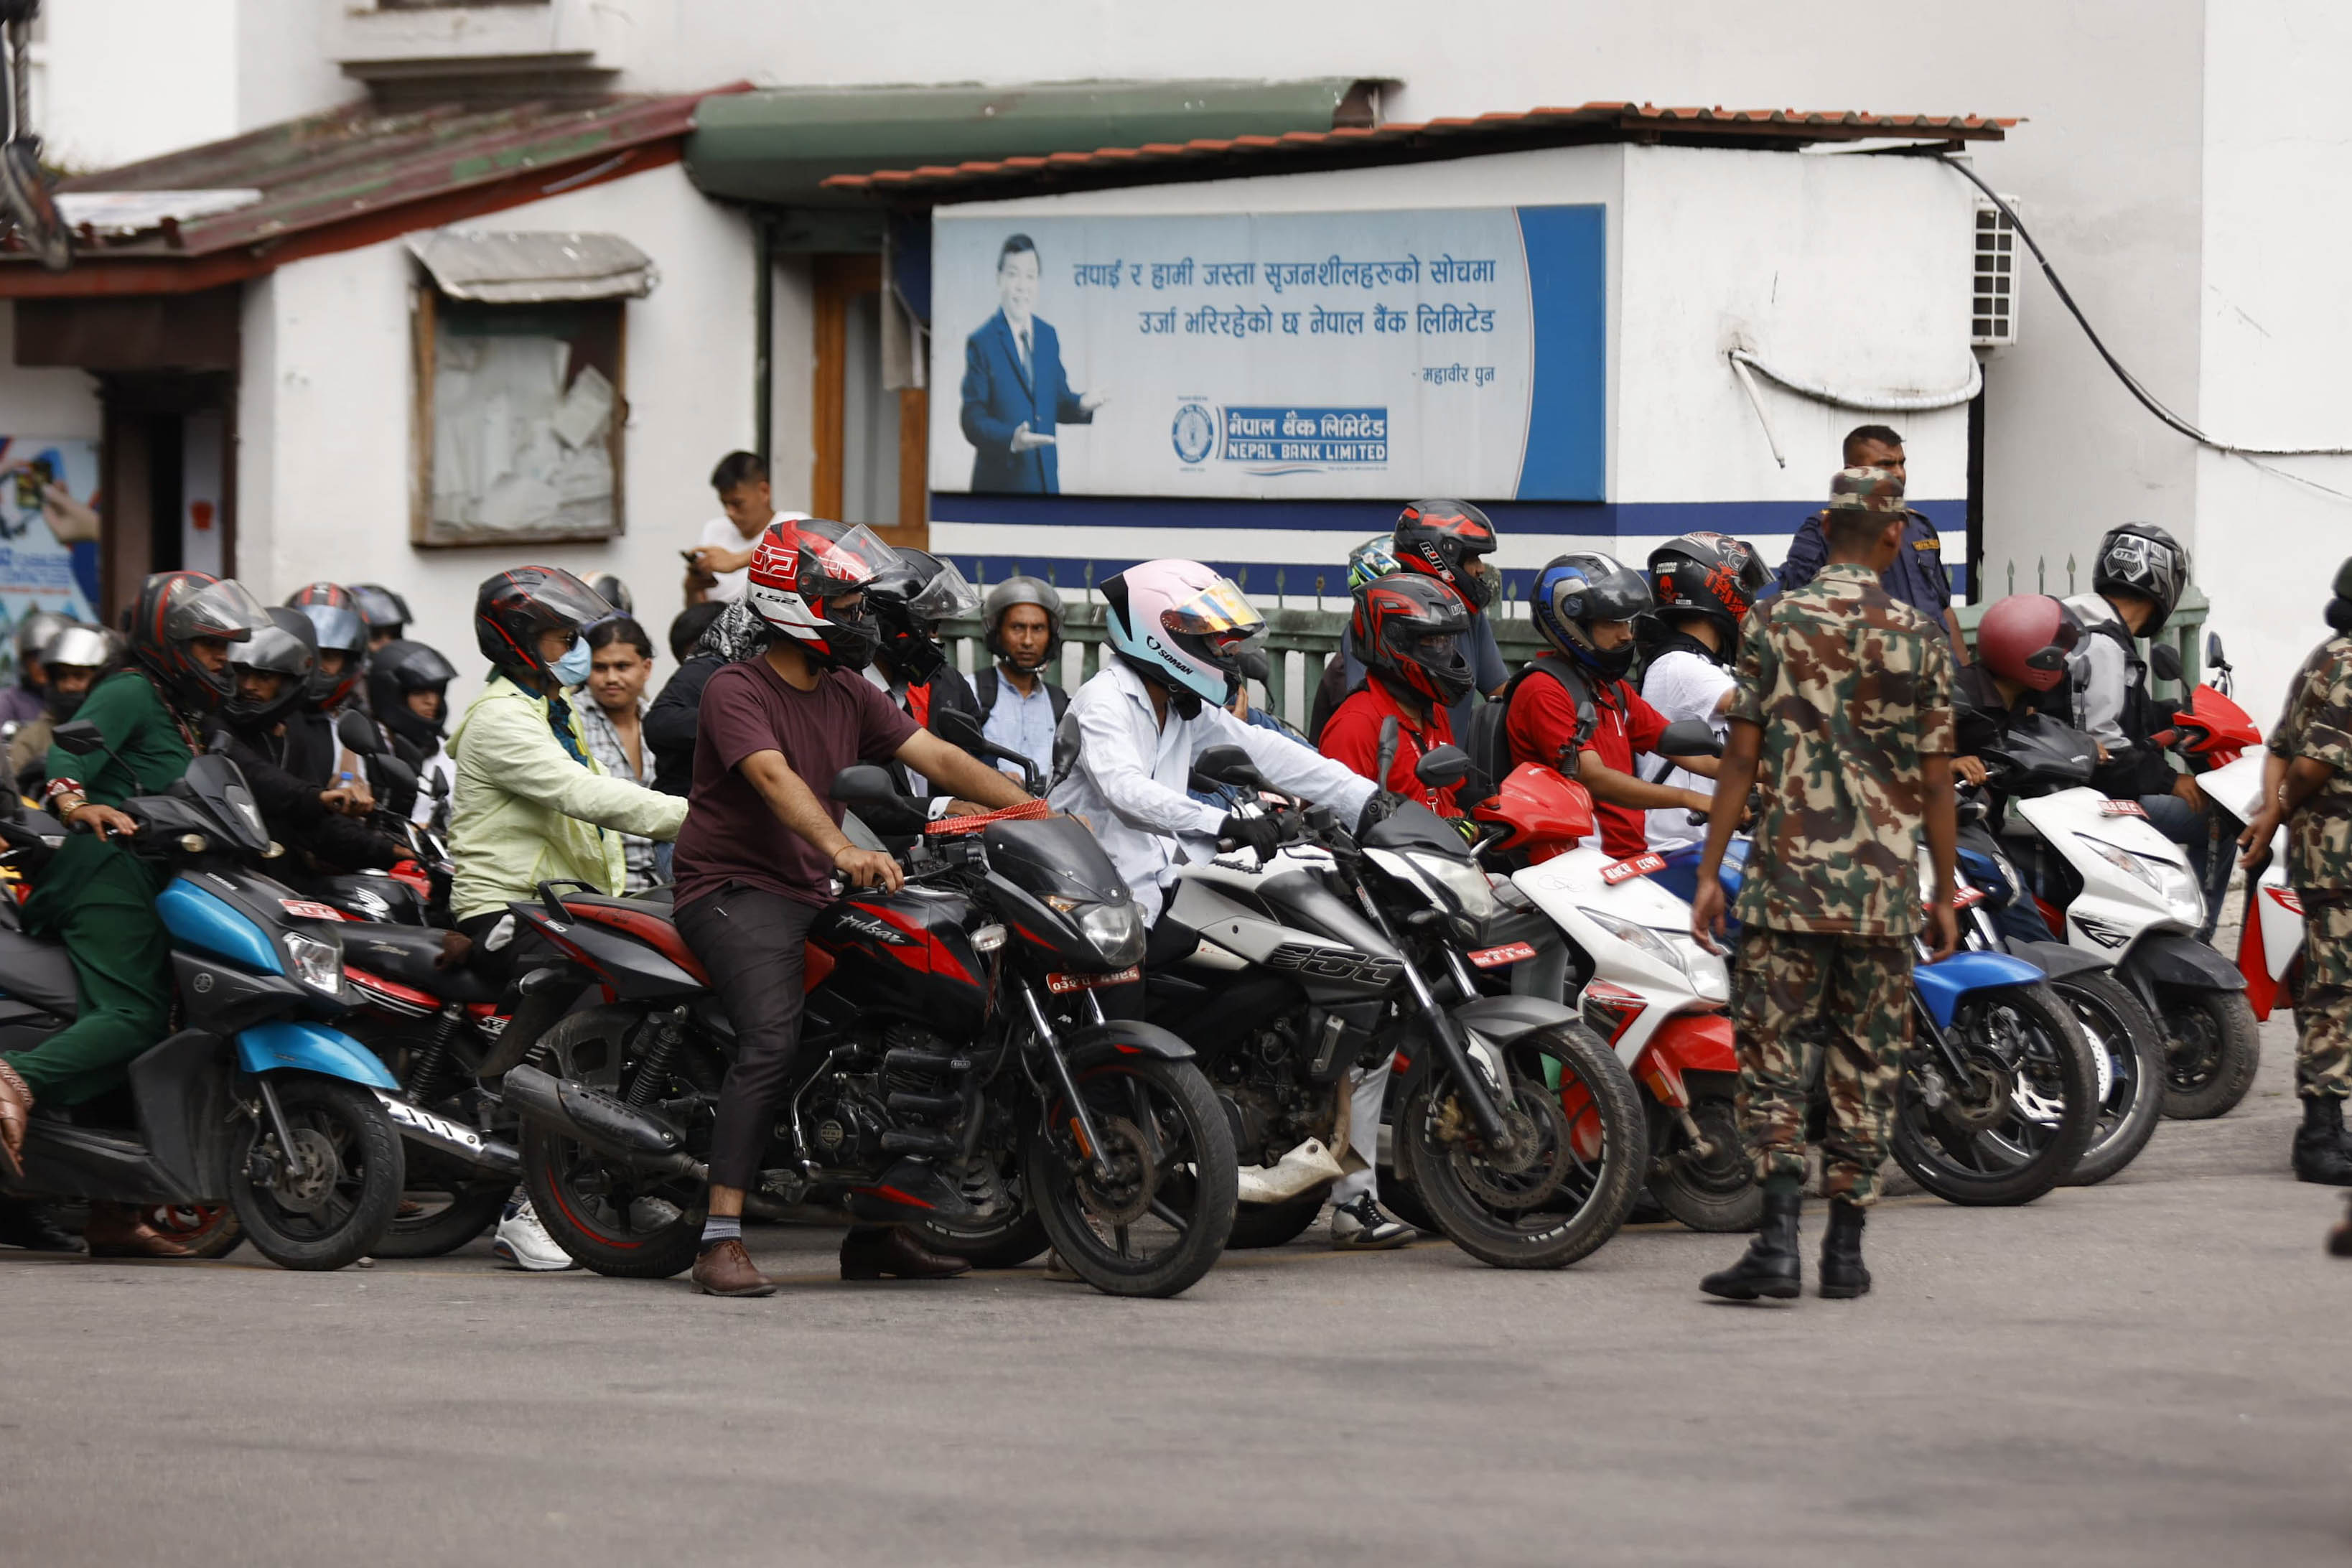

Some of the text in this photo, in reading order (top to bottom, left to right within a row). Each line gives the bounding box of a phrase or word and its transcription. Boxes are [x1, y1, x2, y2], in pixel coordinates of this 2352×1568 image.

[1129, 263, 1142, 286] र
[1150, 256, 1194, 289] हामी
[1202, 262, 1256, 286] जस्ता
[1429, 253, 1496, 283] सोचमा
[1139, 302, 1495, 338] उर्जा भरिरहेको छ नेपाल बैंक लिमिटेड
[1422, 363, 1469, 385] महावीर
[1475, 367, 1494, 387] पुन
[1229, 412, 1276, 437] नेपाल
[1282, 410, 1316, 437] बैंक
[1321, 414, 1385, 437] लिमिटेड
[1228, 443, 1386, 459] NEPAL BANK LIMITED
[755, 592, 798, 606] LS2
[1157, 649, 1194, 676] SOMAN
